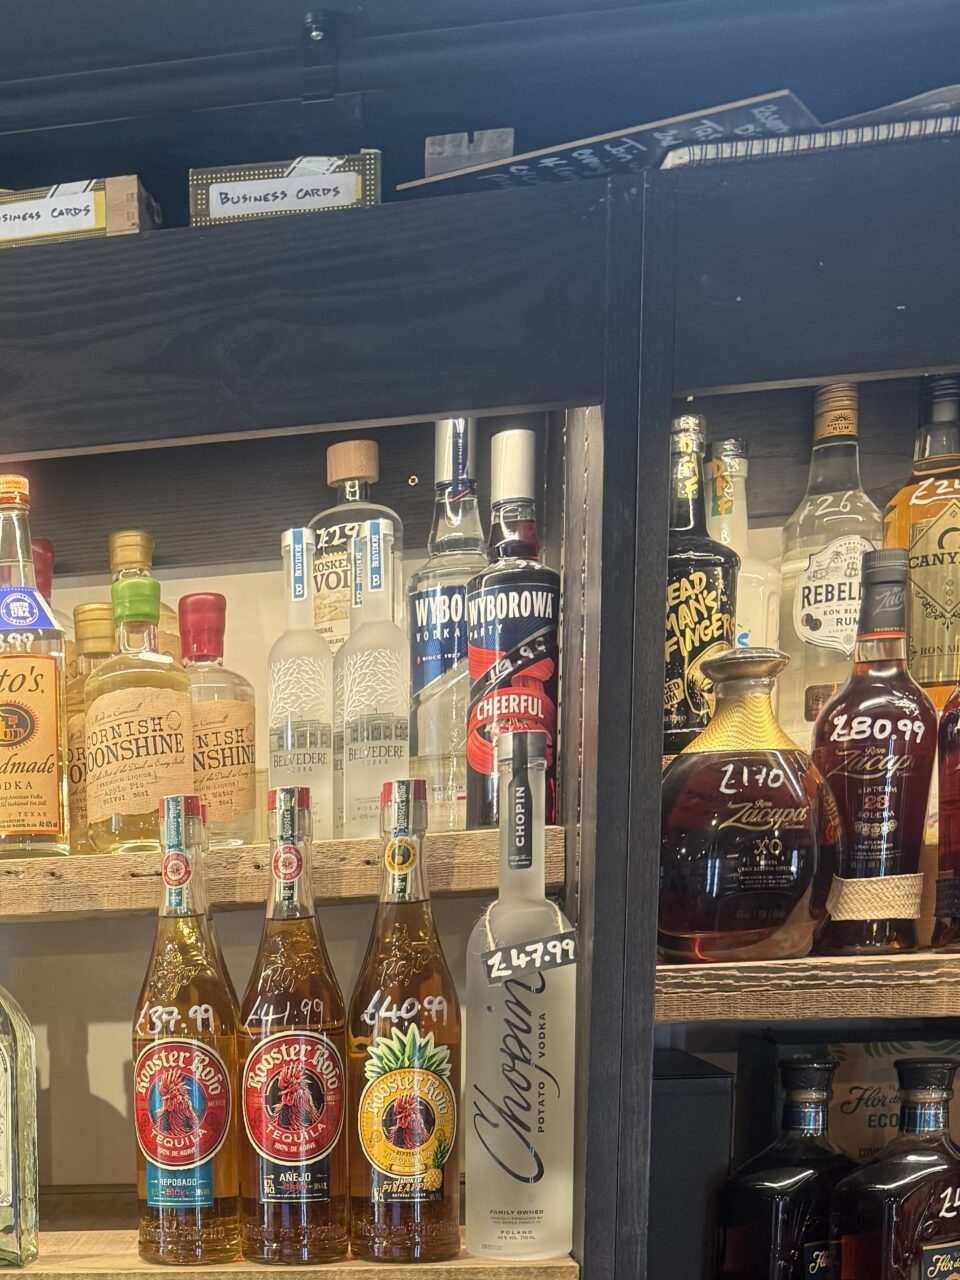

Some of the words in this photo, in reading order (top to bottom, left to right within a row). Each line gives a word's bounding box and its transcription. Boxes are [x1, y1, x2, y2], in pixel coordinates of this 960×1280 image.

[219, 189, 288, 207] BUSINESS
[296, 183, 341, 202] CARDS
[50, 204, 91, 221] CARDS
[294, 543, 303, 577] BELVEDERE
[371, 534, 381, 568] BELVEDERE
[468, 591, 554, 623] WYBOROWA
[416, 628, 460, 642] VODKA
[469, 624, 503, 640] PARTY
[477, 695, 545, 720] CHEERFUL
[86, 715, 164, 750] CORNISH
[829, 716, 925, 743] £80.99
[273, 752, 328, 768] BELVEDERE
[348, 745, 404, 762] BELVEDERE
[720, 763, 785, 794] £170
[515, 785, 528, 849] CHOPIN
[490, 938, 576, 979] £47.99
[135, 1001, 215, 1039] £37.99
[242, 997, 325, 1040] £41.99
[360, 994, 449, 1027] £40.99
[538, 1011, 547, 1059] VODKA
[538, 1080, 546, 1135] POTATO
[150, 1126, 208, 1148] TEQUILA
[263, 1122, 327, 1144] TEQUILA
[159, 1177, 198, 1186] REPOSADO
[279, 1171, 312, 1182] AÑEJO
